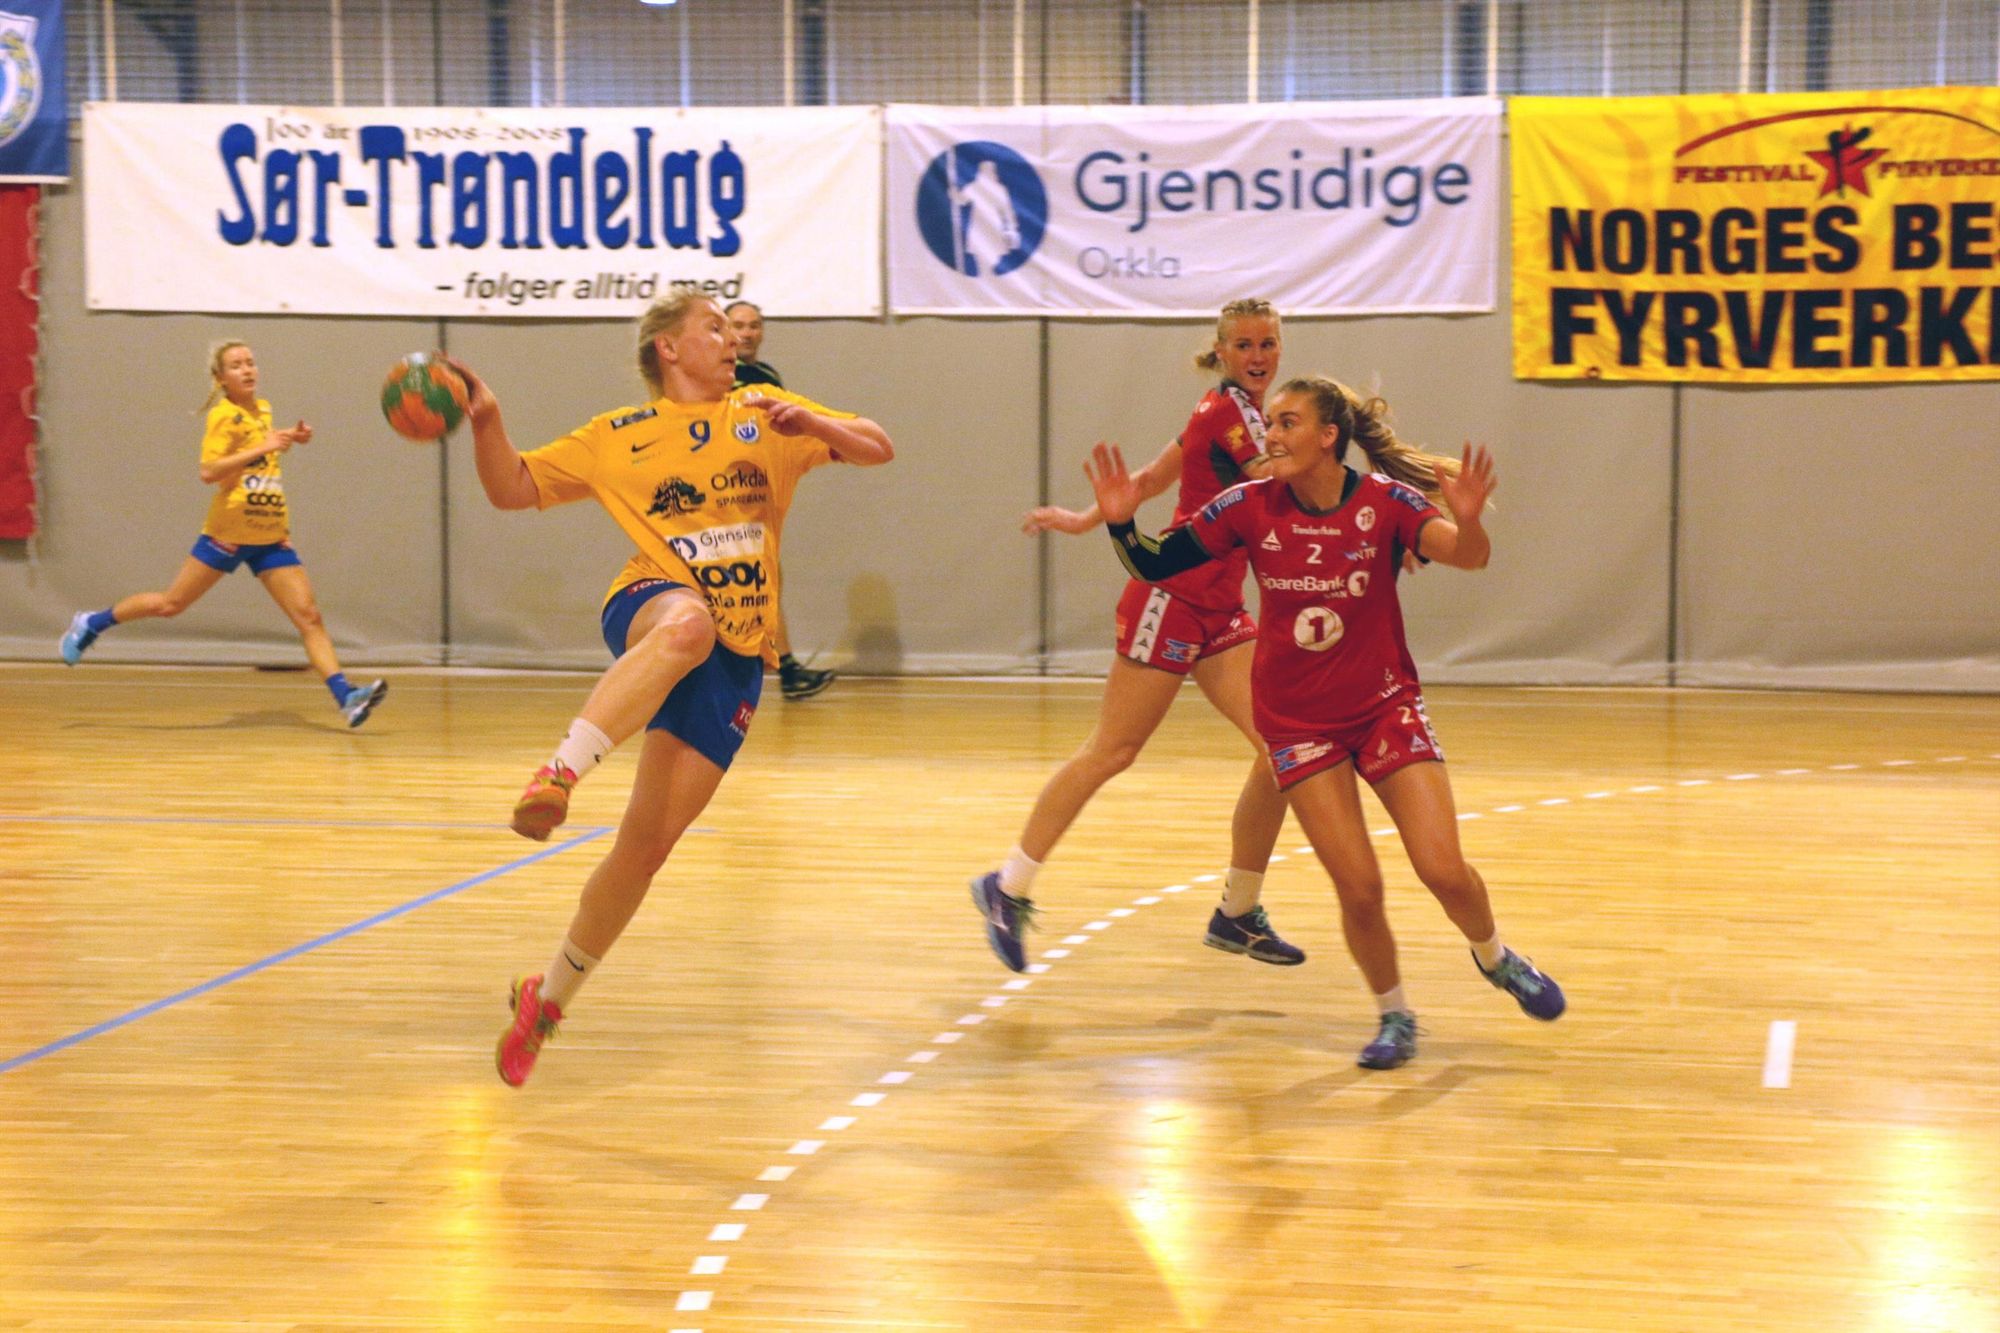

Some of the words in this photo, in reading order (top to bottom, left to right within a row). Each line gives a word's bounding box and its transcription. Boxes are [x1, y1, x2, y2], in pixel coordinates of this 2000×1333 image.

[216, 121, 747, 258] Sør-Trøndelag
[1073, 147, 1472, 233] Gjensidige
[1673, 164, 1816, 184] FESTIVAL
[1549, 205, 1861, 275] NORGES
[1892, 202, 2000, 272] BE
[1077, 246, 1181, 280] Orkla
[463, 272, 566, 305] følger
[572, 272, 659, 300] alltid
[689, 420, 711, 452] 9
[1306, 543, 1323, 565] 2
[1260, 572, 1346, 592] SpareBank
[1397, 706, 1415, 725] 2
